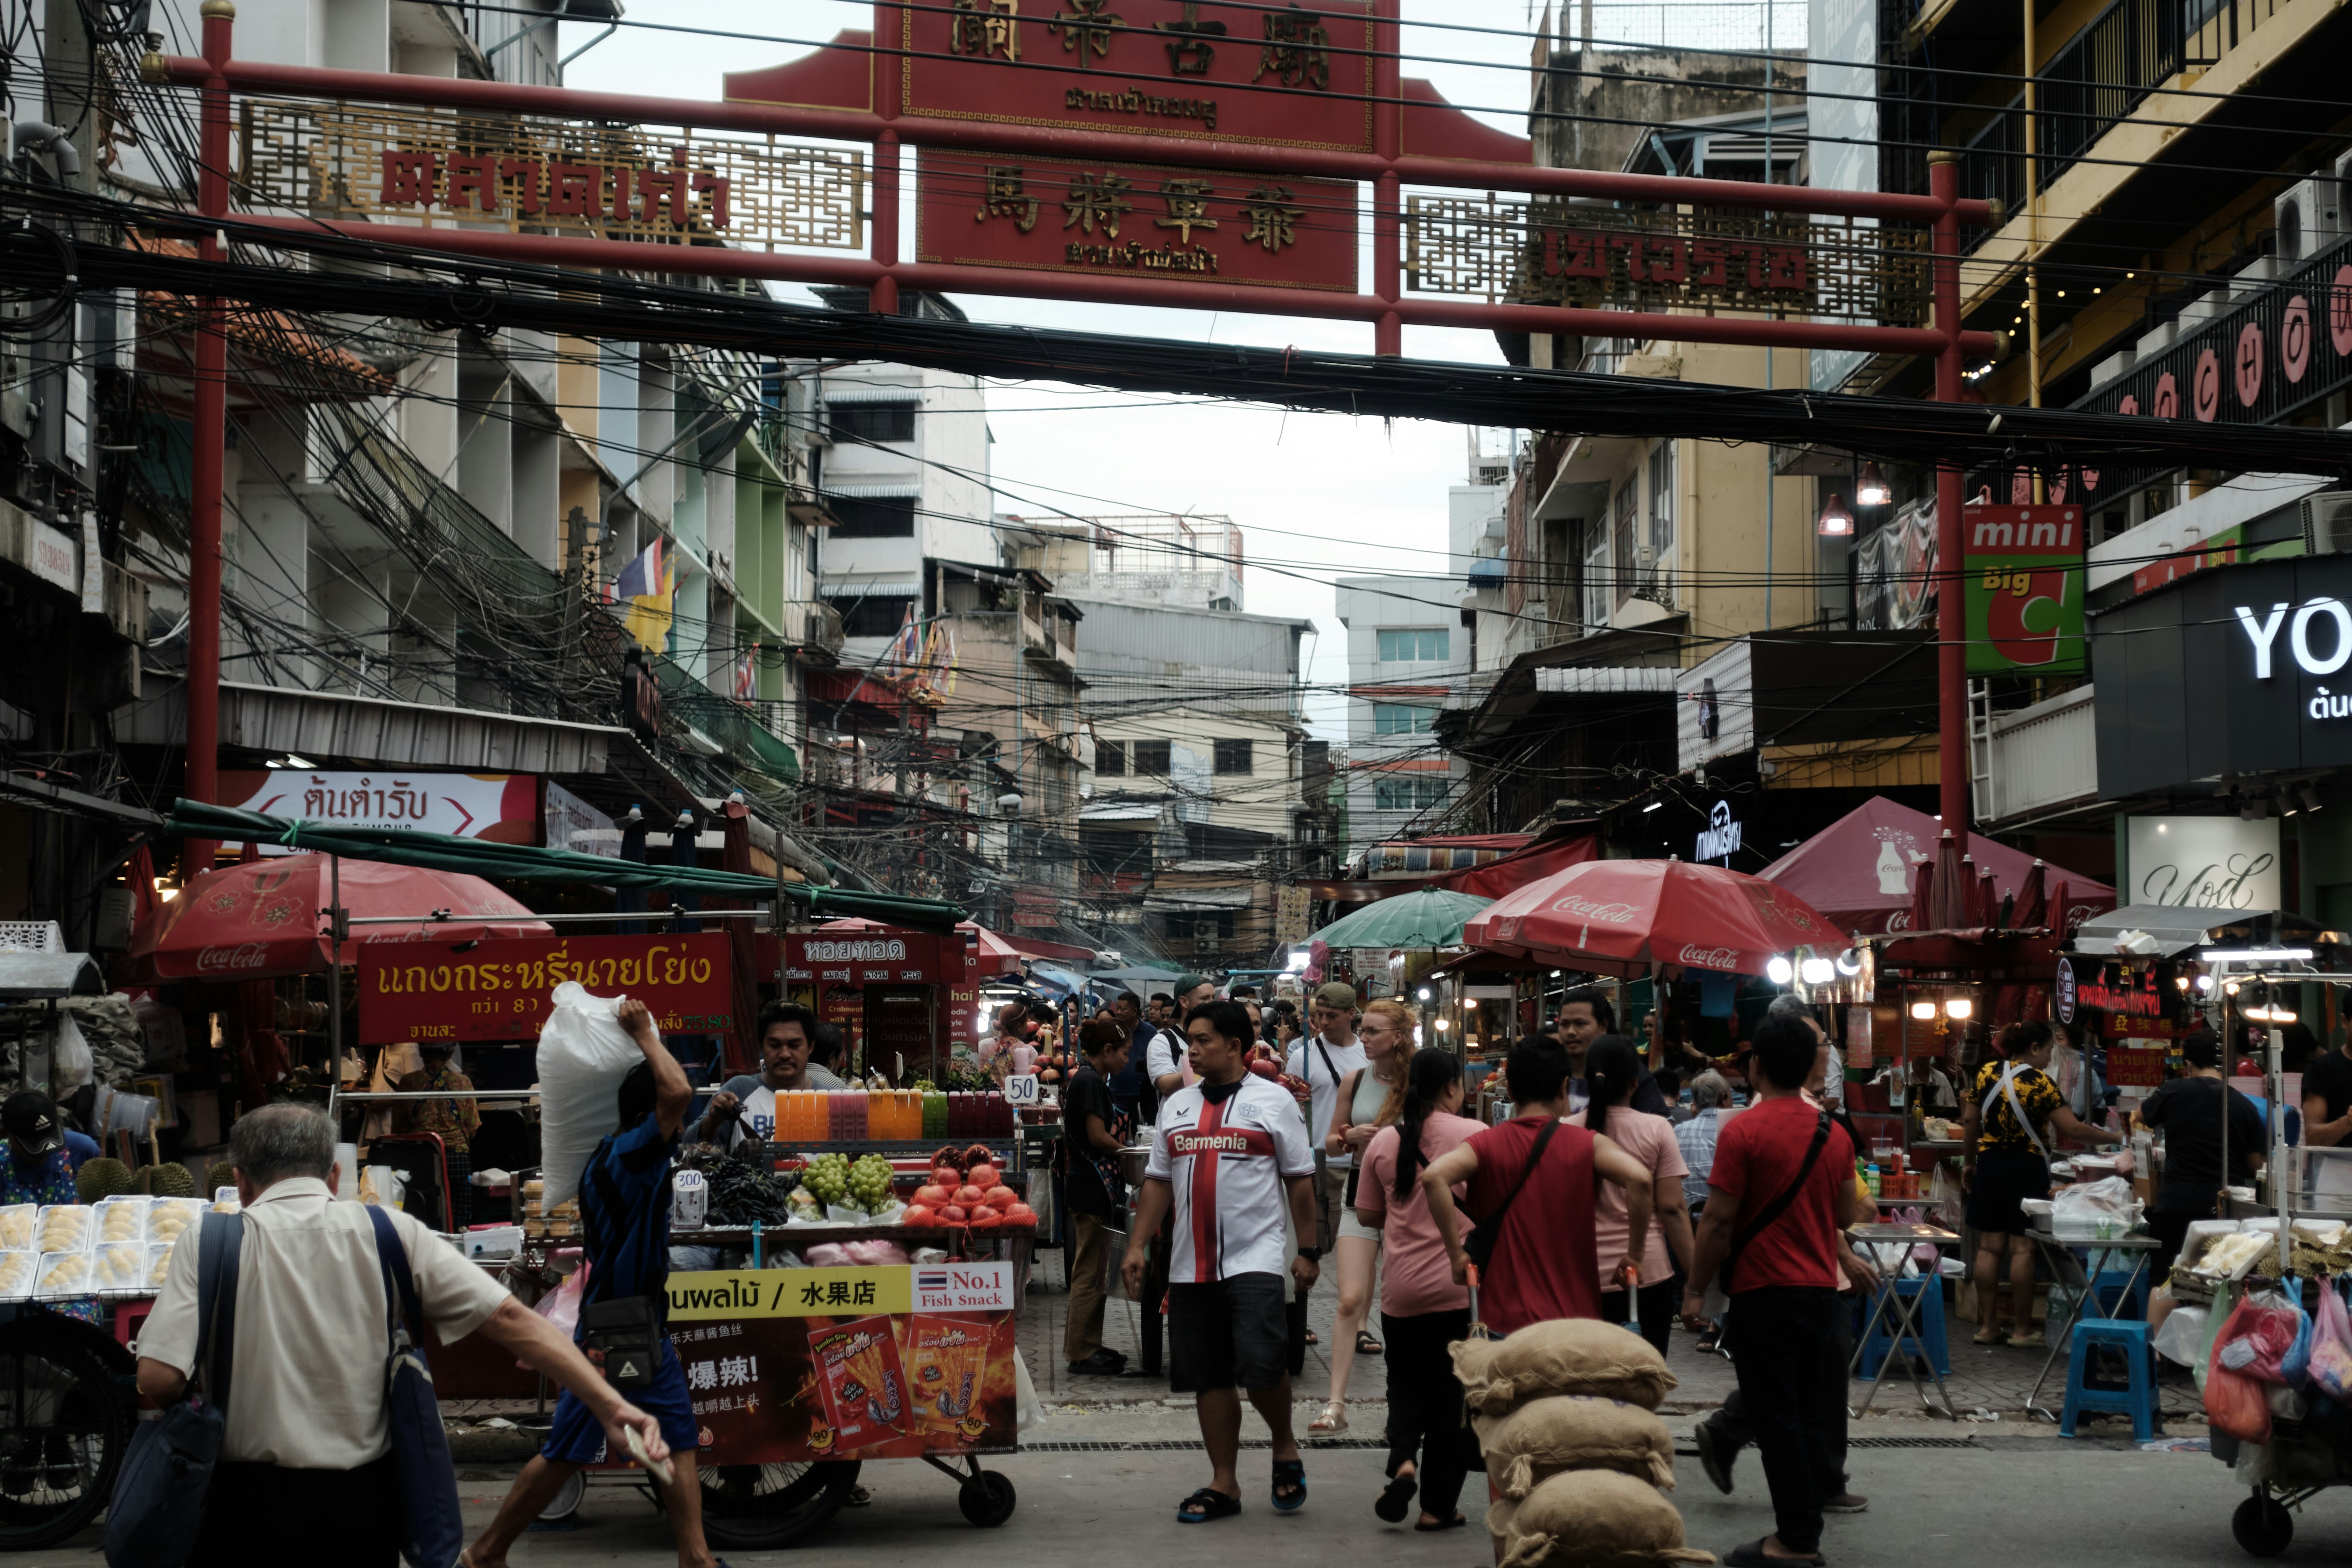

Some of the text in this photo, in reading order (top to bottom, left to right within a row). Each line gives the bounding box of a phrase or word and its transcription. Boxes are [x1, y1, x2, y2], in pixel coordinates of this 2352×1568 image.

[380, 146, 731, 229] ตลาดเก่า
[975, 164, 1305, 253] 馬將軍爺
[1541, 226, 1808, 291] เยาวราช
[1973, 511, 2074, 546] mini
[1982, 567, 2032, 596] Big
[303, 775, 427, 820] ต้นตำรับ
[803, 939, 906, 962] หอยทอด
[822, 967, 850, 982] แมลงภู่
[863, 970, 888, 980] นางรม
[900, 970, 922, 980] ทะเล
[410, 1025, 456, 1038] จานละ
[1011, 1078, 1033, 1099] 50
[1174, 1132, 1247, 1152] Barmenia
[677, 1174, 702, 1187] 300
[953, 1271, 1002, 1290] No.1
[801, 1280, 876, 1307] 水果店
[921, 1292, 1003, 1307] Fish Snack
[815, 1336, 835, 1352] Jumbo
[688, 1356, 759, 1390] 爆辣!
[967, 1417, 981, 1428] 60
[814, 1430, 828, 1441] 90
